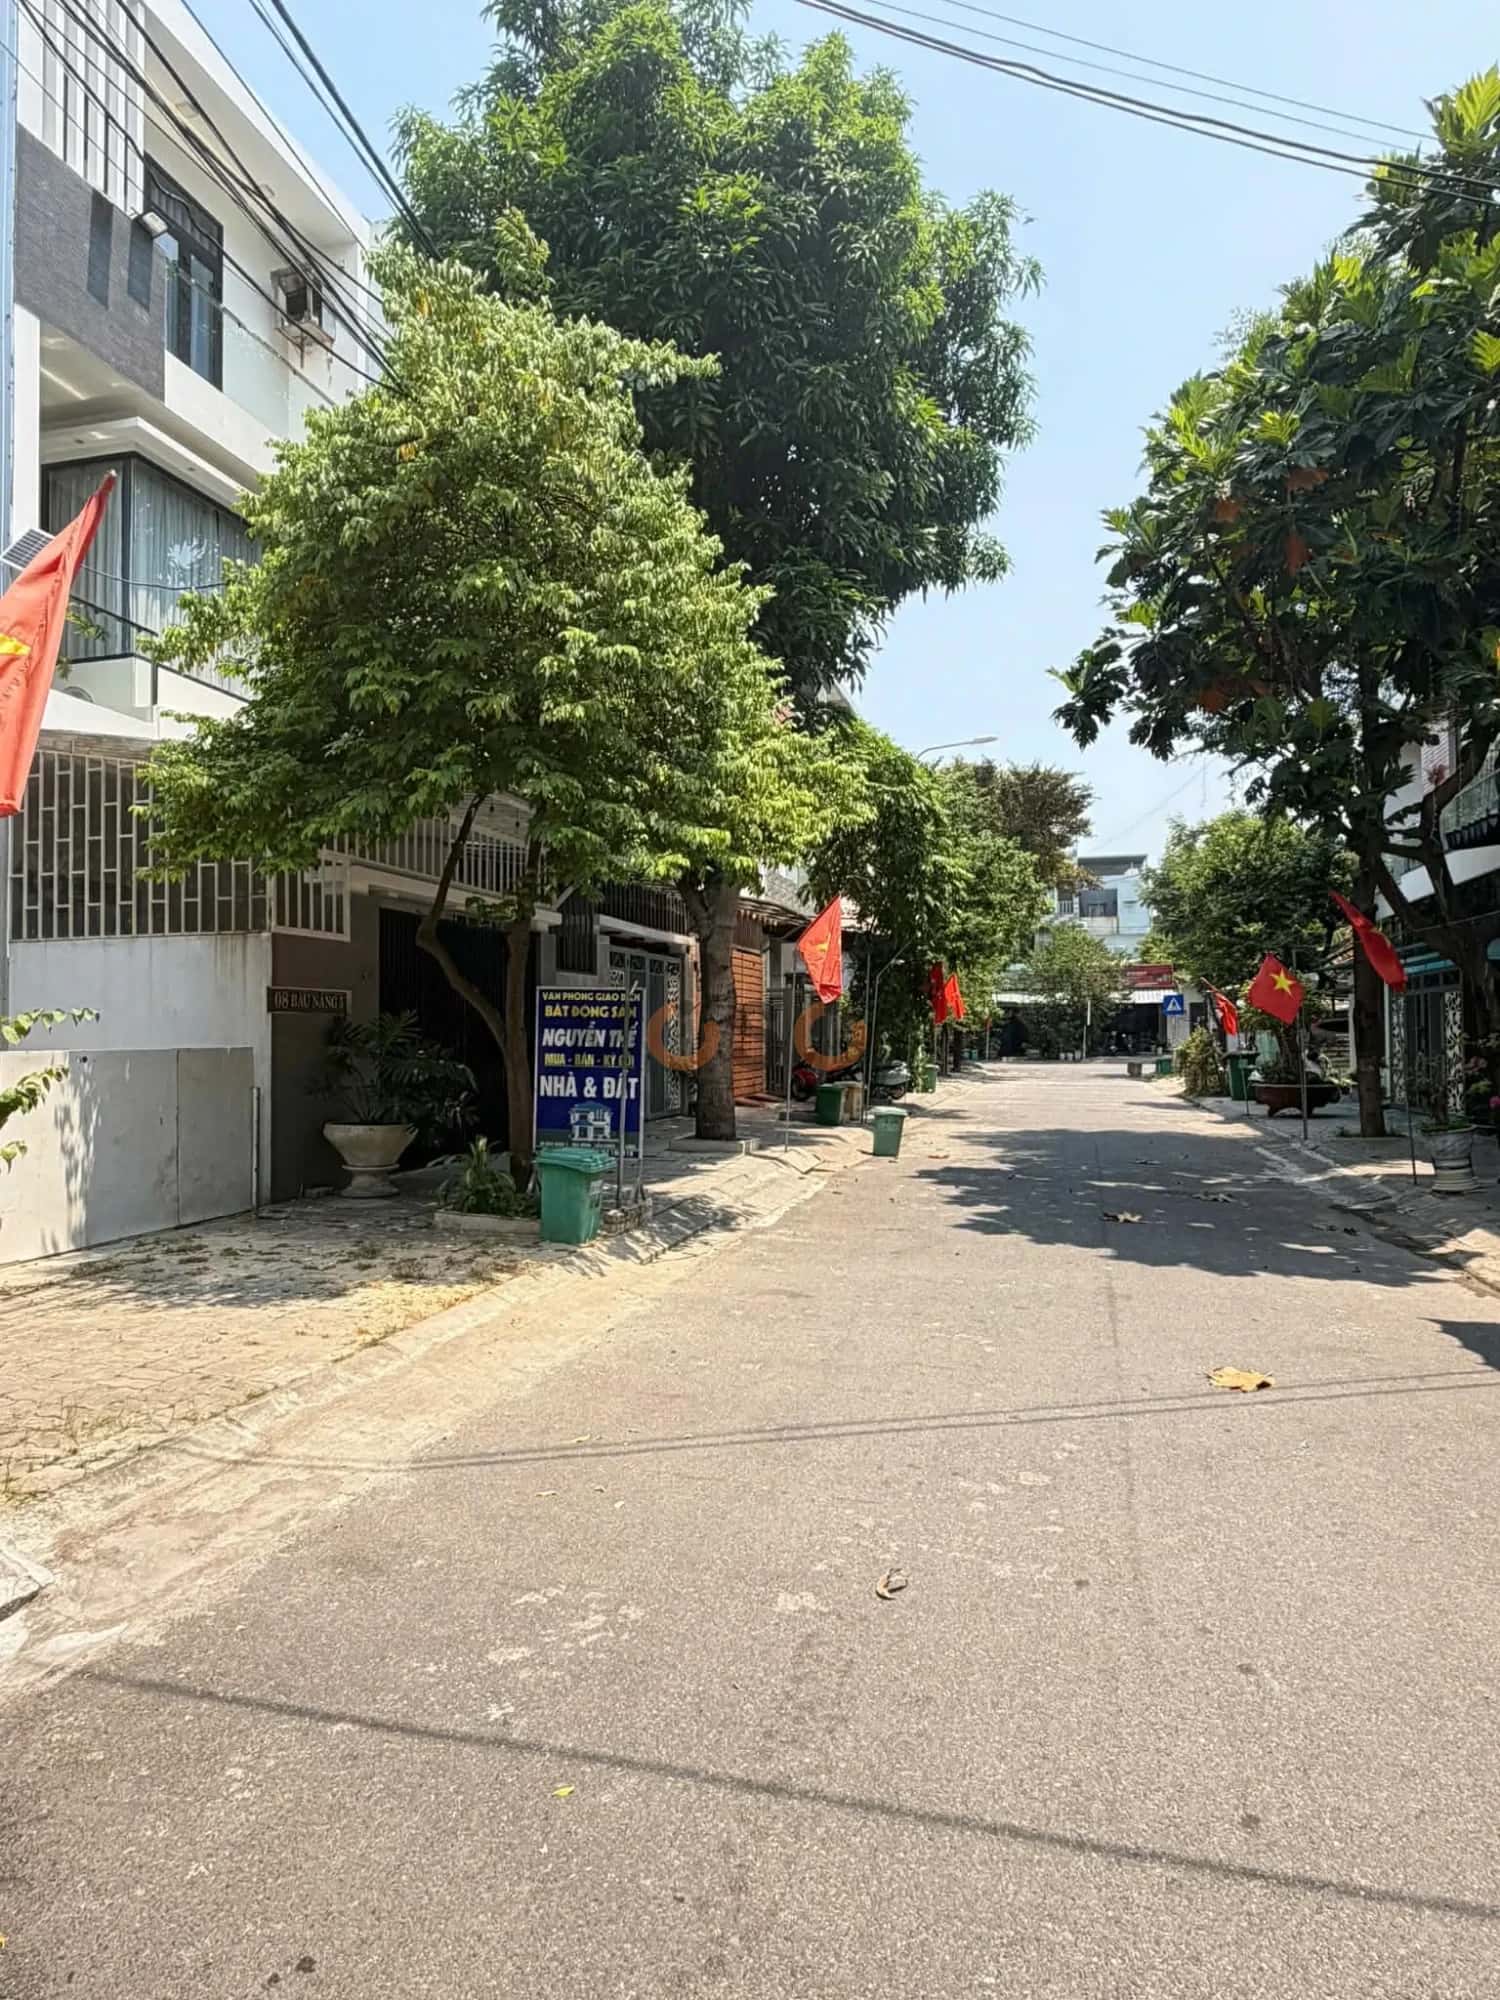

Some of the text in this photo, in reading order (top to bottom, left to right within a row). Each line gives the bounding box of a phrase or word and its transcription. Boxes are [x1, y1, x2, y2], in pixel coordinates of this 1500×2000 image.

[595, 992, 619, 1001] GIAO
[544, 1052, 566, 1066] MUA
[574, 1052, 595, 1067] BÁN
[540, 1072, 578, 1097] NHÀ
[583, 1077, 597, 1098] &
